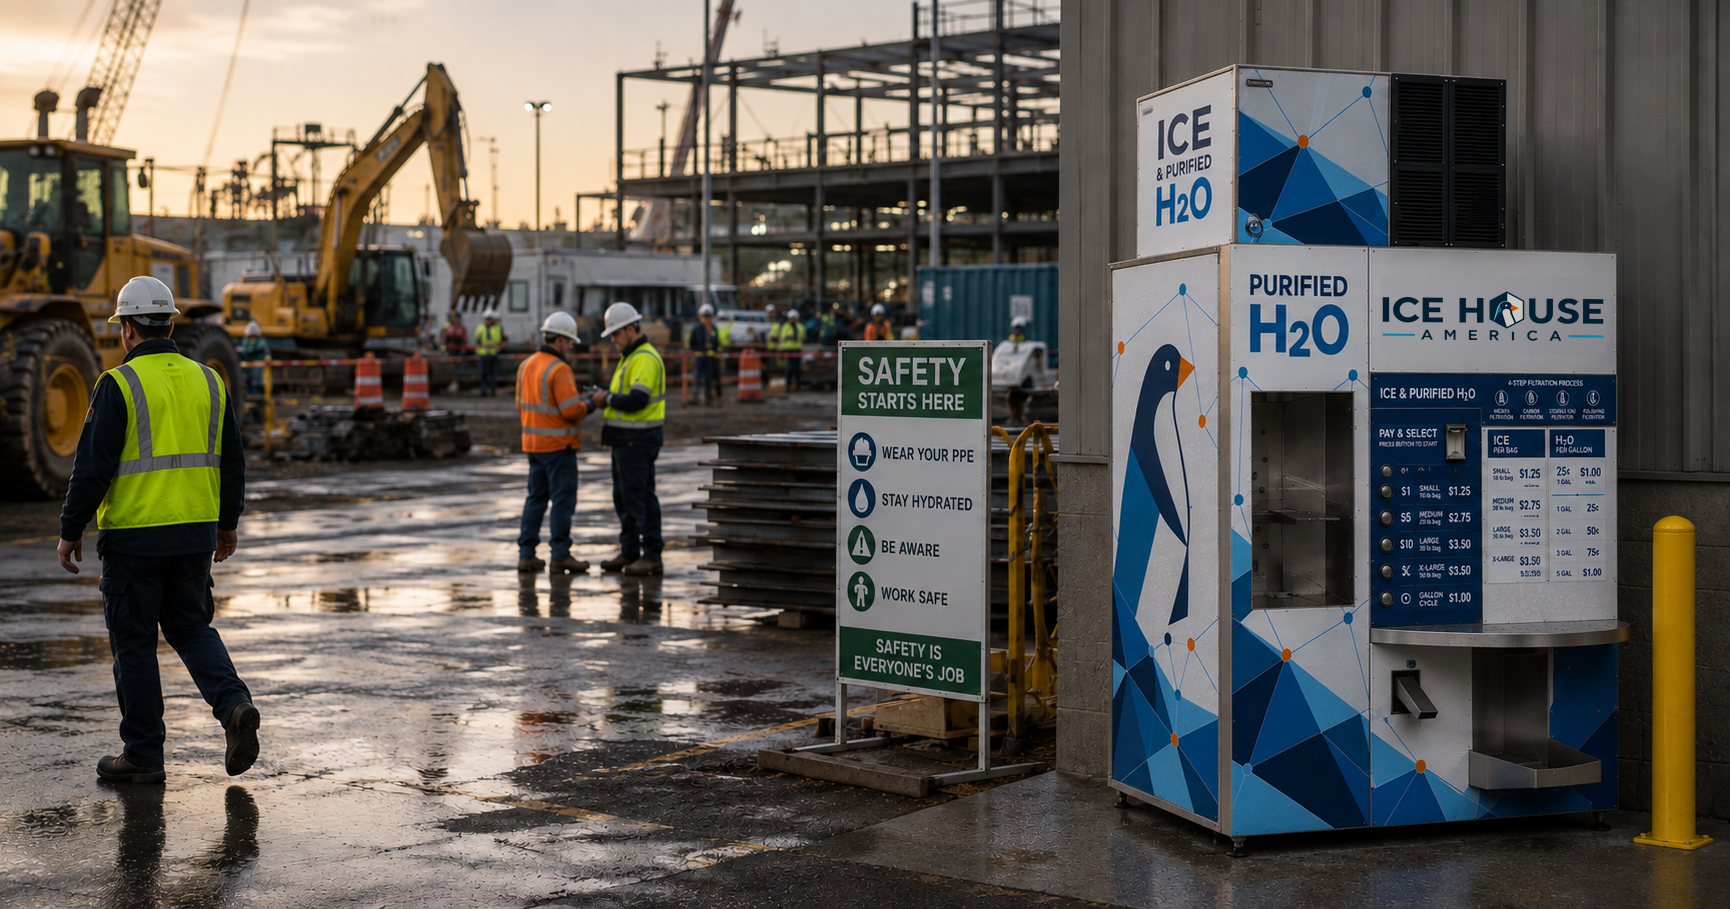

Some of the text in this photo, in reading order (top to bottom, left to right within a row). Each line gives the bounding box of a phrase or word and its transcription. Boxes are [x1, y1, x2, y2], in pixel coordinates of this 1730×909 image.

[1158, 104, 1212, 160] ICE
[1156, 154, 1212, 181] & PURIFIED
[1156, 176, 1212, 227] H2O
[1249, 273, 1348, 297] PURIFIED
[1382, 296, 1443, 323] ICE
[1249, 303, 1350, 358] H2O
[1421, 329, 1562, 342] AMERICA
[858, 356, 966, 386] SAFETY
[1380, 387, 1398, 400] ICE
[1399, 387, 1407, 400] &
[1409, 387, 1454, 400] PURIFIED
[858, 392, 965, 411] STARTS HERE
[1378, 428, 1438, 438] PAY & SELECT
[1493, 435, 1510, 445] ICE
[881, 445, 974, 463] WEAR YOUR PPE
[1568, 446, 1593, 454] GALLON
[1519, 468, 1541, 479] $1.25
[1580, 467, 1601, 477] $1.00
[1448, 486, 1471, 497] $1.25
[881, 493, 973, 511] STAY HYDRATED
[1519, 499, 1541, 510] $2.75
[1448, 512, 1471, 523] $2.75
[1519, 528, 1541, 538] $3.50
[1419, 537, 1440, 545] LARGE
[1448, 539, 1471, 550] $3.50
[881, 540, 940, 557] BE AWARE
[1519, 556, 1541, 566] $3.50
[1418, 563, 1445, 571] X-LARGE
[1448, 565, 1471, 576] $3.50
[1582, 568, 1602, 577] $1.00
[881, 586, 948, 606] WORK SAFE
[1418, 591, 1443, 599] GALLON
[1448, 592, 1472, 603] $1.00
[875, 638, 942, 660] SAFETY IS
[854, 655, 965, 684] EVERYONE'S JOB
